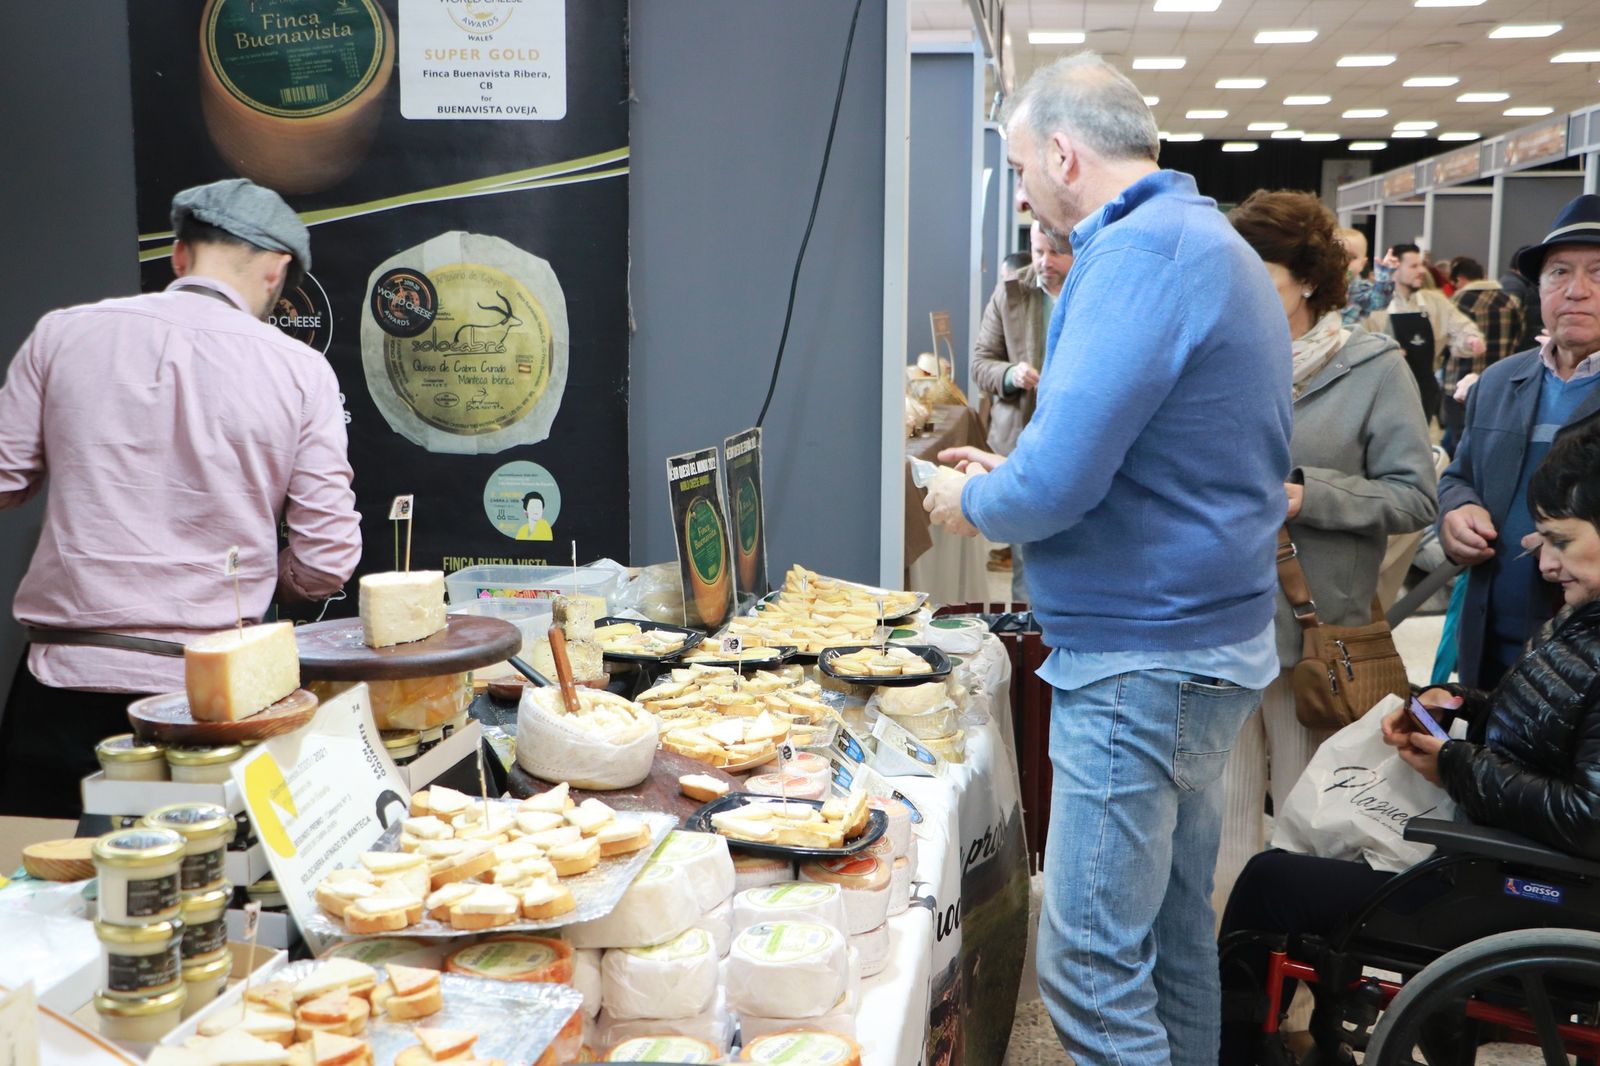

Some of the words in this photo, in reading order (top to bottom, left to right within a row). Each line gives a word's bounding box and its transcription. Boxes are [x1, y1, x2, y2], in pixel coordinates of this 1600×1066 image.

[261, 12, 321, 31] Finca
[462, 15, 500, 29] AWARDS
[233, 21, 353, 50] Buenavista
[467, 34, 494, 42] WALES
[424, 48, 481, 61] SUPER
[488, 48, 541, 61] GOLD
[422, 69, 450, 78] Finca
[453, 69, 510, 78] Buenavista
[513, 69, 551, 79] Ribera,
[479, 81, 493, 90] CB
[437, 105, 503, 114] BUENAVISTA
[505, 105, 538, 116] OVEJA
[384, 310, 411, 326] AWARDS
[405, 302, 433, 320] CHEESE
[279, 315, 322, 328] CHEESE
[411, 326, 507, 353] solocabra
[412, 359, 437, 373] Queso
[439, 360, 449, 373] de
[453, 360, 478, 373] Cabra
[480, 360, 507, 373] Curado
[457, 374, 488, 385] Manteca
[442, 556, 475, 571] FINCA
[477, 557, 514, 567] BUENA
[358, 722, 387, 777] GOURMETS
[1323, 765, 1438, 826] Plazuel
[345, 815, 372, 840] MANTECA
[1522, 884, 1560, 898] ORSSO
